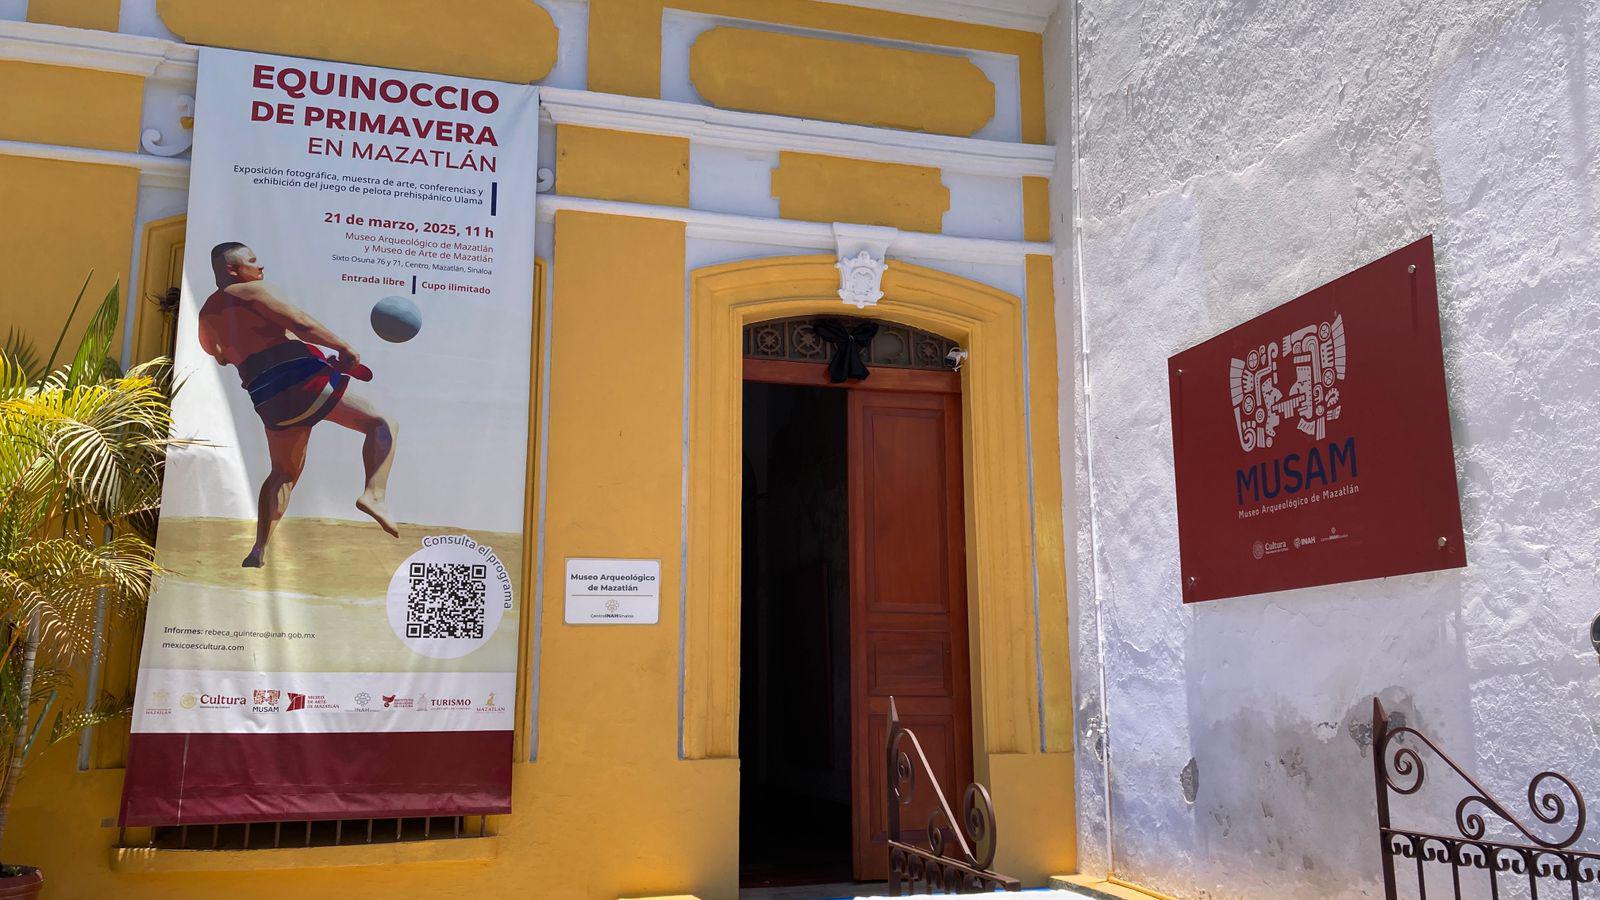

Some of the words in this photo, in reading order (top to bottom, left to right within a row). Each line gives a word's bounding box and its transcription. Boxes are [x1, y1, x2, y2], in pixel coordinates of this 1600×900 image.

[253, 64, 499, 114] EQUINOCCIO
[251, 100, 294, 125] DE
[304, 106, 498, 146] PRIMAVERA
[308, 137, 342, 156] EN
[352, 141, 496, 173] MAZATLÁN
[234, 165, 283, 175] Exposición
[287, 169, 339, 181] fotográfica,
[342, 175, 380, 185] muestra
[383, 178, 394, 186] de
[397, 180, 416, 190] arte,
[420, 183, 476, 195] conferencias
[478, 189, 483, 197] y
[253, 177, 300, 187] exhibición
[320, 182, 346, 192] juego
[349, 184, 360, 192] de
[363, 187, 391, 196] pelota
[394, 190, 452, 202] prehispánico
[455, 196, 483, 205] Ulama
[324, 212, 341, 223] 21
[346, 214, 364, 225] de
[368, 218, 419, 233] marzo,
[423, 222, 460, 237] 2025,
[465, 226, 480, 237] 11
[486, 227, 494, 238] h
[346, 232, 376, 242] Museo
[378, 235, 437, 249] Arqueológico
[454, 243, 493, 253] Mazatlán
[332, 254, 349, 262] Sixto
[351, 256, 374, 264] Osuna
[405, 261, 430, 270] Centro,
[432, 264, 465, 273] Mazatlán,
[468, 267, 492, 275] Sinaloa
[364, 245, 369, 253] y
[372, 245, 402, 255] Museo
[405, 248, 416, 256] de
[419, 250, 437, 258] Arte
[454, 253, 493, 263] Mazatlán
[342, 274, 380, 284] Entrada
[383, 277, 404, 286] libre
[422, 282, 445, 291] Cupo
[449, 283, 490, 294] ilimitado
[1236, 437, 1357, 506] MUSAM
[1239, 509, 1260, 519] Museo
[1262, 496, 1308, 514] Arqueológico
[1311, 494, 1320, 503] de
[1323, 485, 1359, 500] Mazatlán
[1265, 541, 1286, 551] Cultura
[1301, 536, 1315, 545] INAH
[424, 536, 476, 550] Consulta
[478, 547, 490, 557] el
[486, 555, 512, 609] programa
[600, 574, 655, 582] Arqueológico
[164, 627, 203, 636] Informes:
[162, 642, 244, 651] mexicoescultura.com
[200, 694, 246, 705] Cultura
